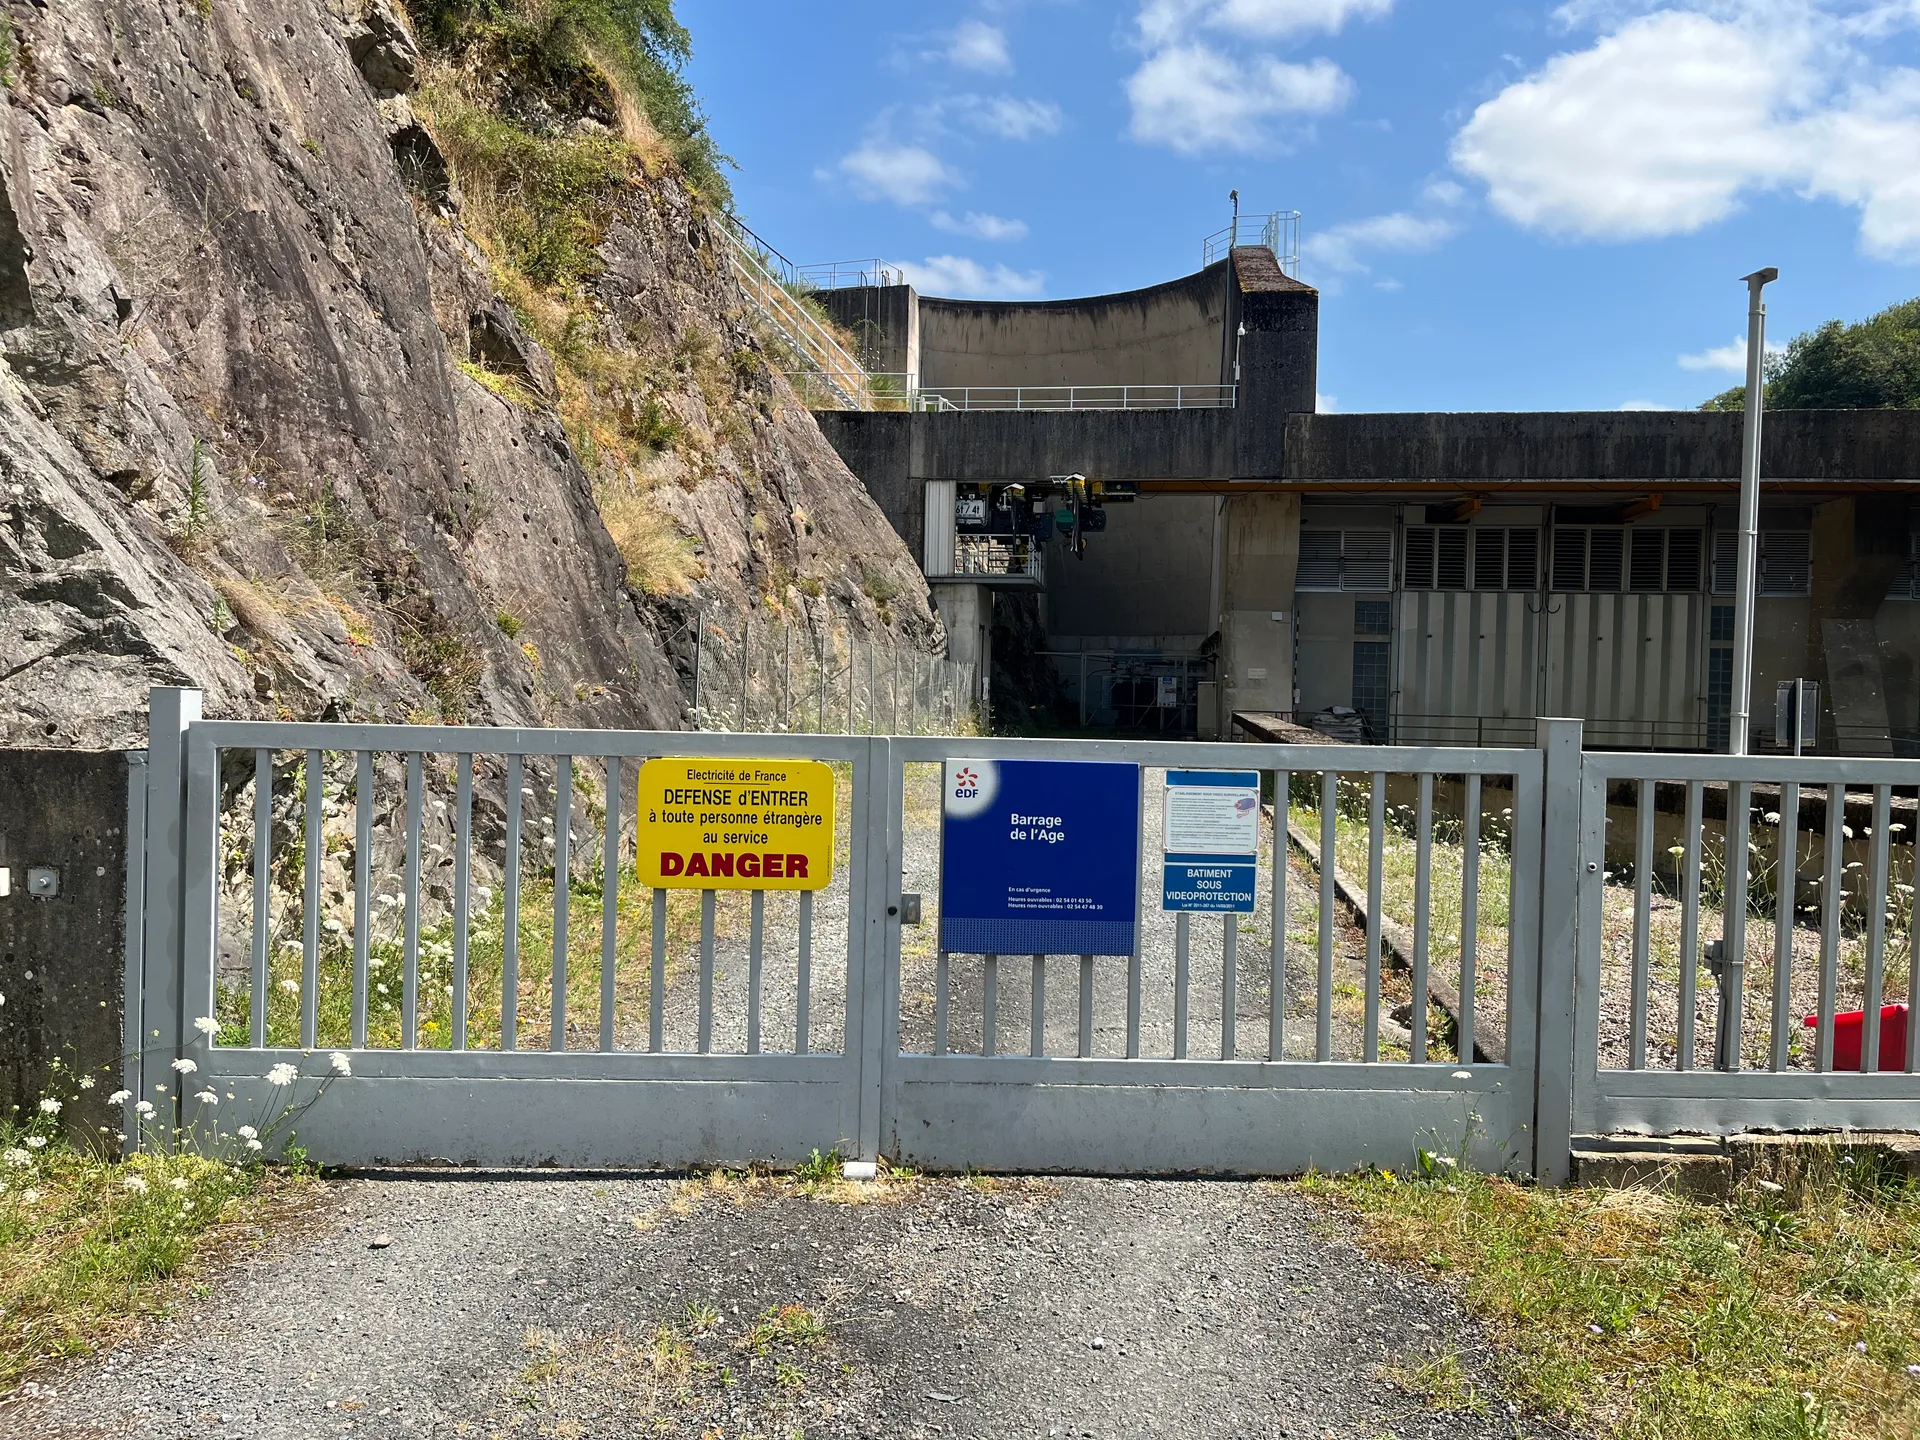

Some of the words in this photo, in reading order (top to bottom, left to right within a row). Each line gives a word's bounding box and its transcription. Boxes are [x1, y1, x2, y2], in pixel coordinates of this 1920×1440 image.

[687, 769, 735, 780] Electricité
[739, 770, 750, 780] de
[754, 770, 786, 782] France
[664, 789, 731, 805] DEFENSE
[738, 790, 808, 806] d'ENTRER
[649, 808, 656, 822] à
[662, 810, 694, 823] toute
[700, 813, 758, 826] personne
[764, 810, 822, 828] étrangère
[1010, 813, 1062, 828] Barrage
[703, 833, 718, 844] au
[724, 831, 768, 844] service
[1010, 828, 1026, 840] de
[1030, 828, 1064, 844] l'Age
[660, 852, 808, 878] DANGER
[1187, 869, 1232, 878] BATIMENT
[1196, 880, 1222, 889] SOUS
[1166, 892, 1252, 901] VIDEOPROTECTION
